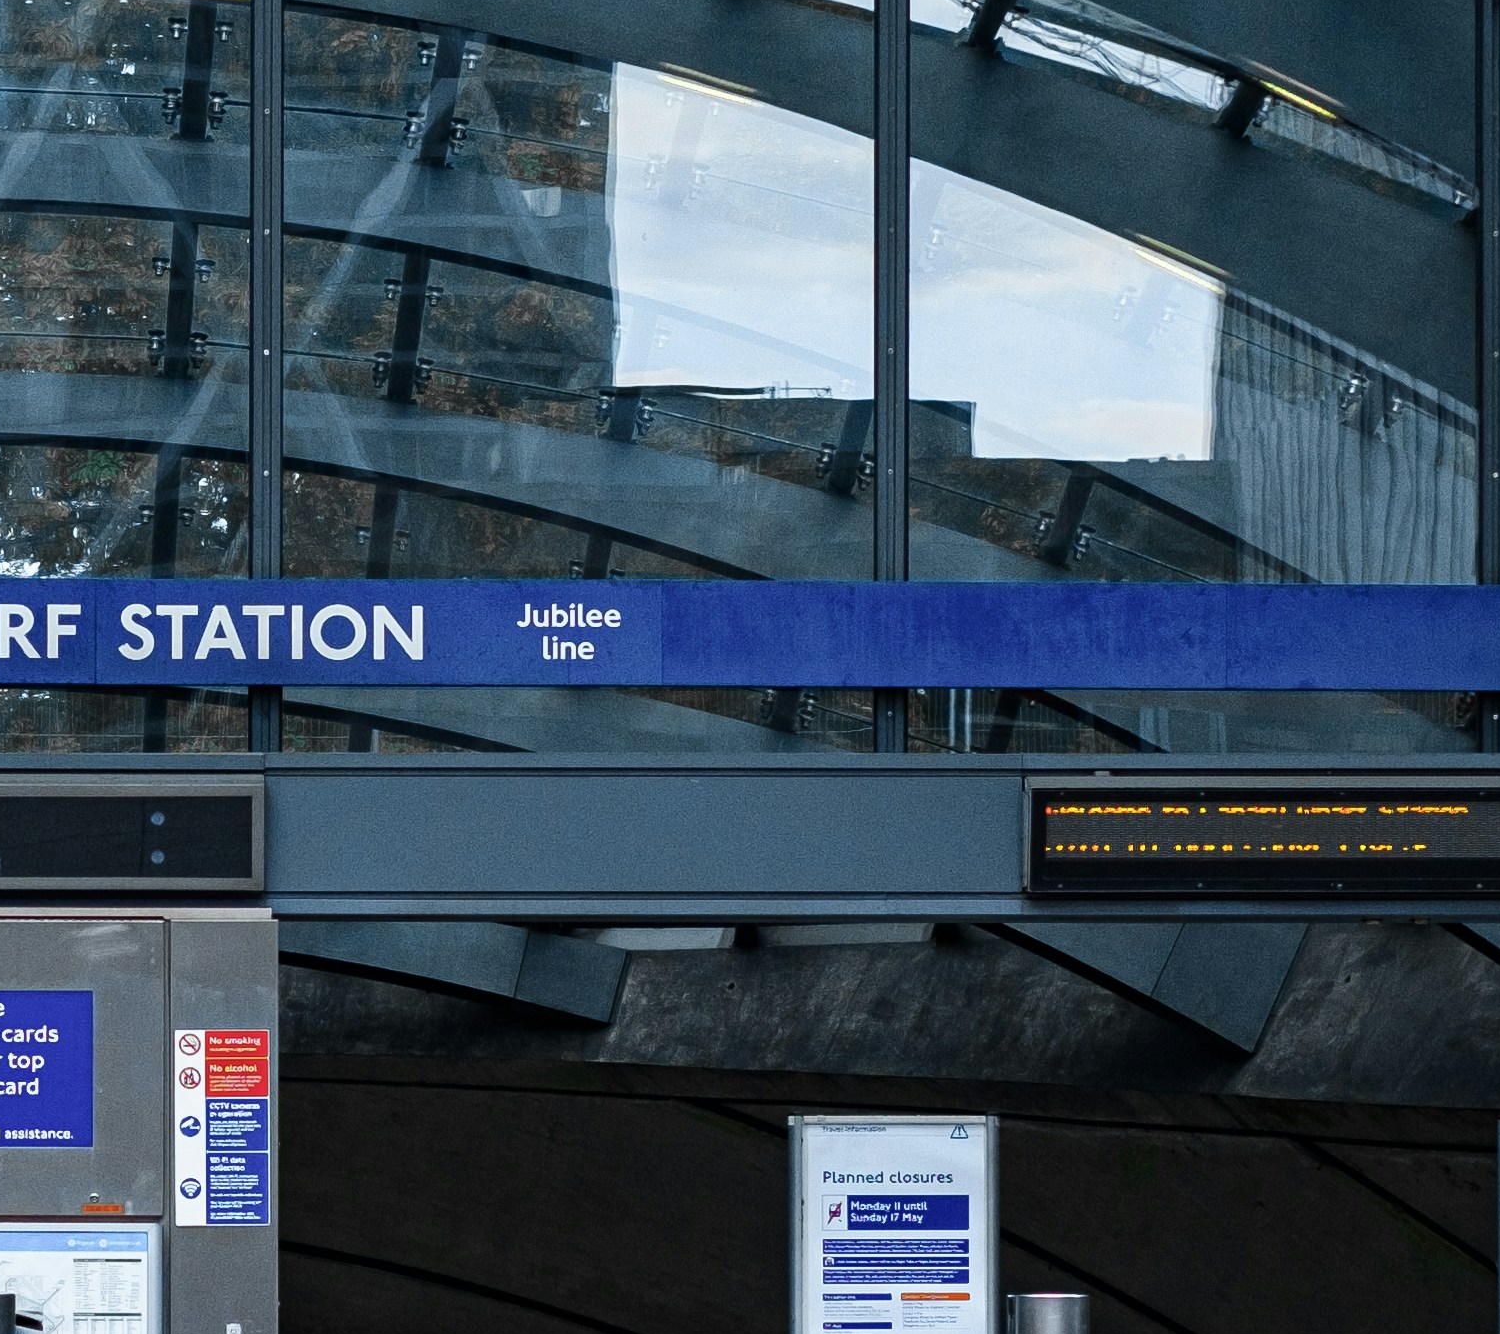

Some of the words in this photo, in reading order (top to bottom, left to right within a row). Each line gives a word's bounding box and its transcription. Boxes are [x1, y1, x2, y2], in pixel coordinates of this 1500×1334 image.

[516, 603, 622, 629] Jubilee
[118, 603, 424, 661] STATION
[542, 636, 595, 660] line
[1, 1025, 59, 1043] cards
[224, 1036, 261, 1046] smoking
[8, 1053, 45, 1072] top
[209, 1064, 223, 1072] No
[224, 1064, 258, 1072] alcohol
[4, 1128, 74, 1140] assistance.
[822, 1171, 883, 1184] Planned
[889, 1171, 954, 1184] closures
[850, 1201, 891, 1212] Monday
[903, 1201, 928, 1211] until
[850, 1213, 888, 1224] Sunday
[890, 1213, 900, 1222] 17
[902, 1213, 924, 1224] May
